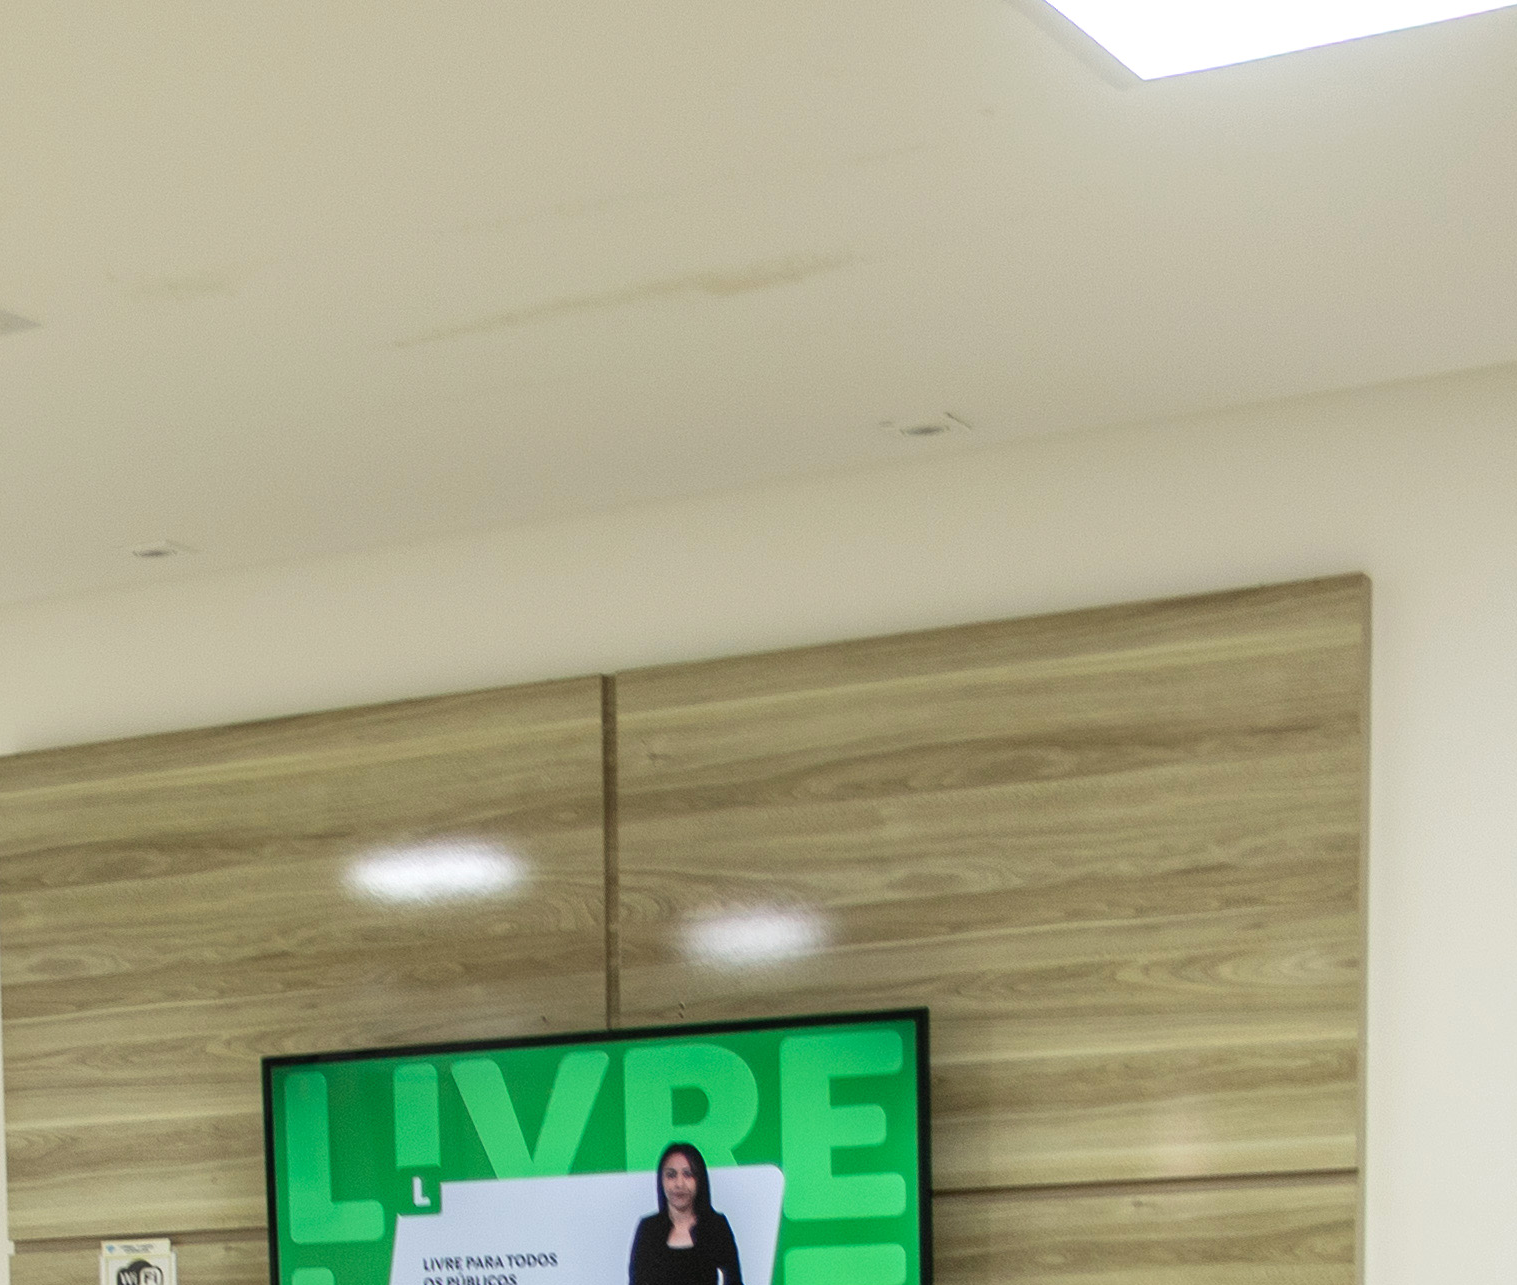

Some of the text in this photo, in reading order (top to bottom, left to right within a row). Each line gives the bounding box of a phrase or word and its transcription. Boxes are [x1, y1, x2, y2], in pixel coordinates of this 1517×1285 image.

[422, 1252, 559, 1273] LIVRE PARA TODOS
